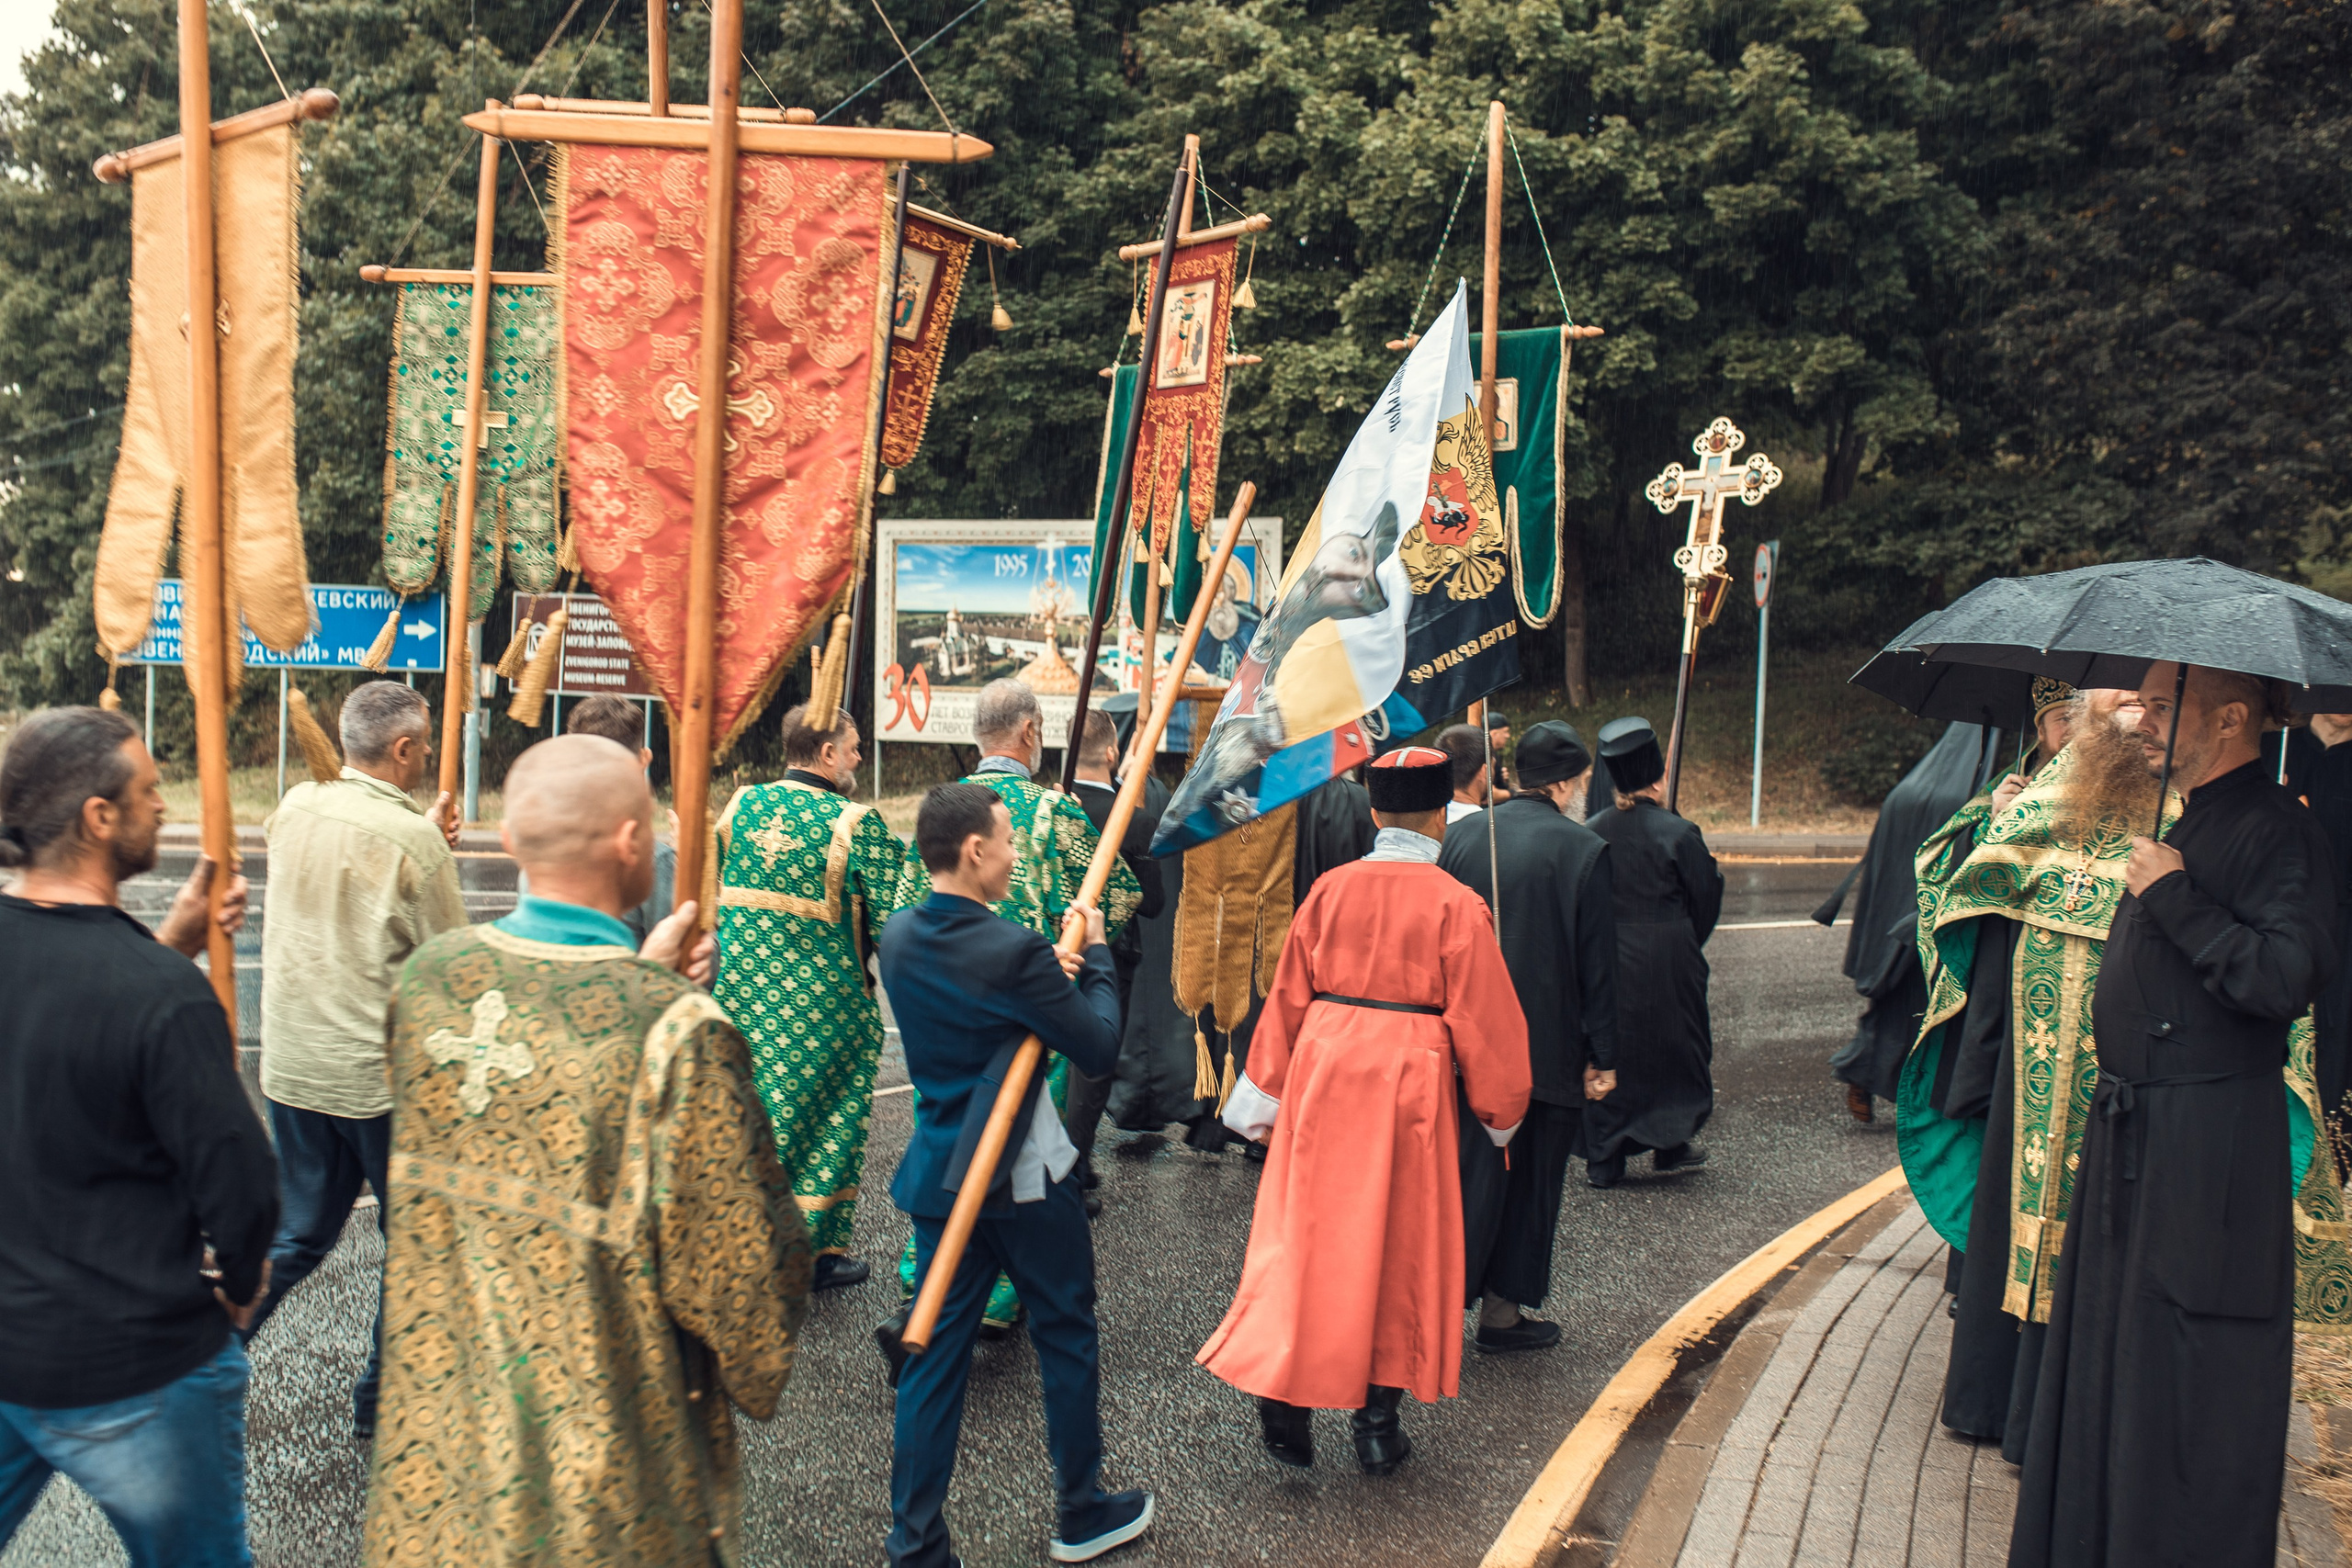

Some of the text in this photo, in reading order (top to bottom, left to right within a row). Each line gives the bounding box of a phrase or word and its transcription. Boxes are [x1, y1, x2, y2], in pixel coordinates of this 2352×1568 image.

[994, 553, 1091, 578] 1995 20
[609, 656, 630, 671] STATE
[564, 671, 627, 687] MUSEUM RESERVE
[883, 662, 931, 733] 30
